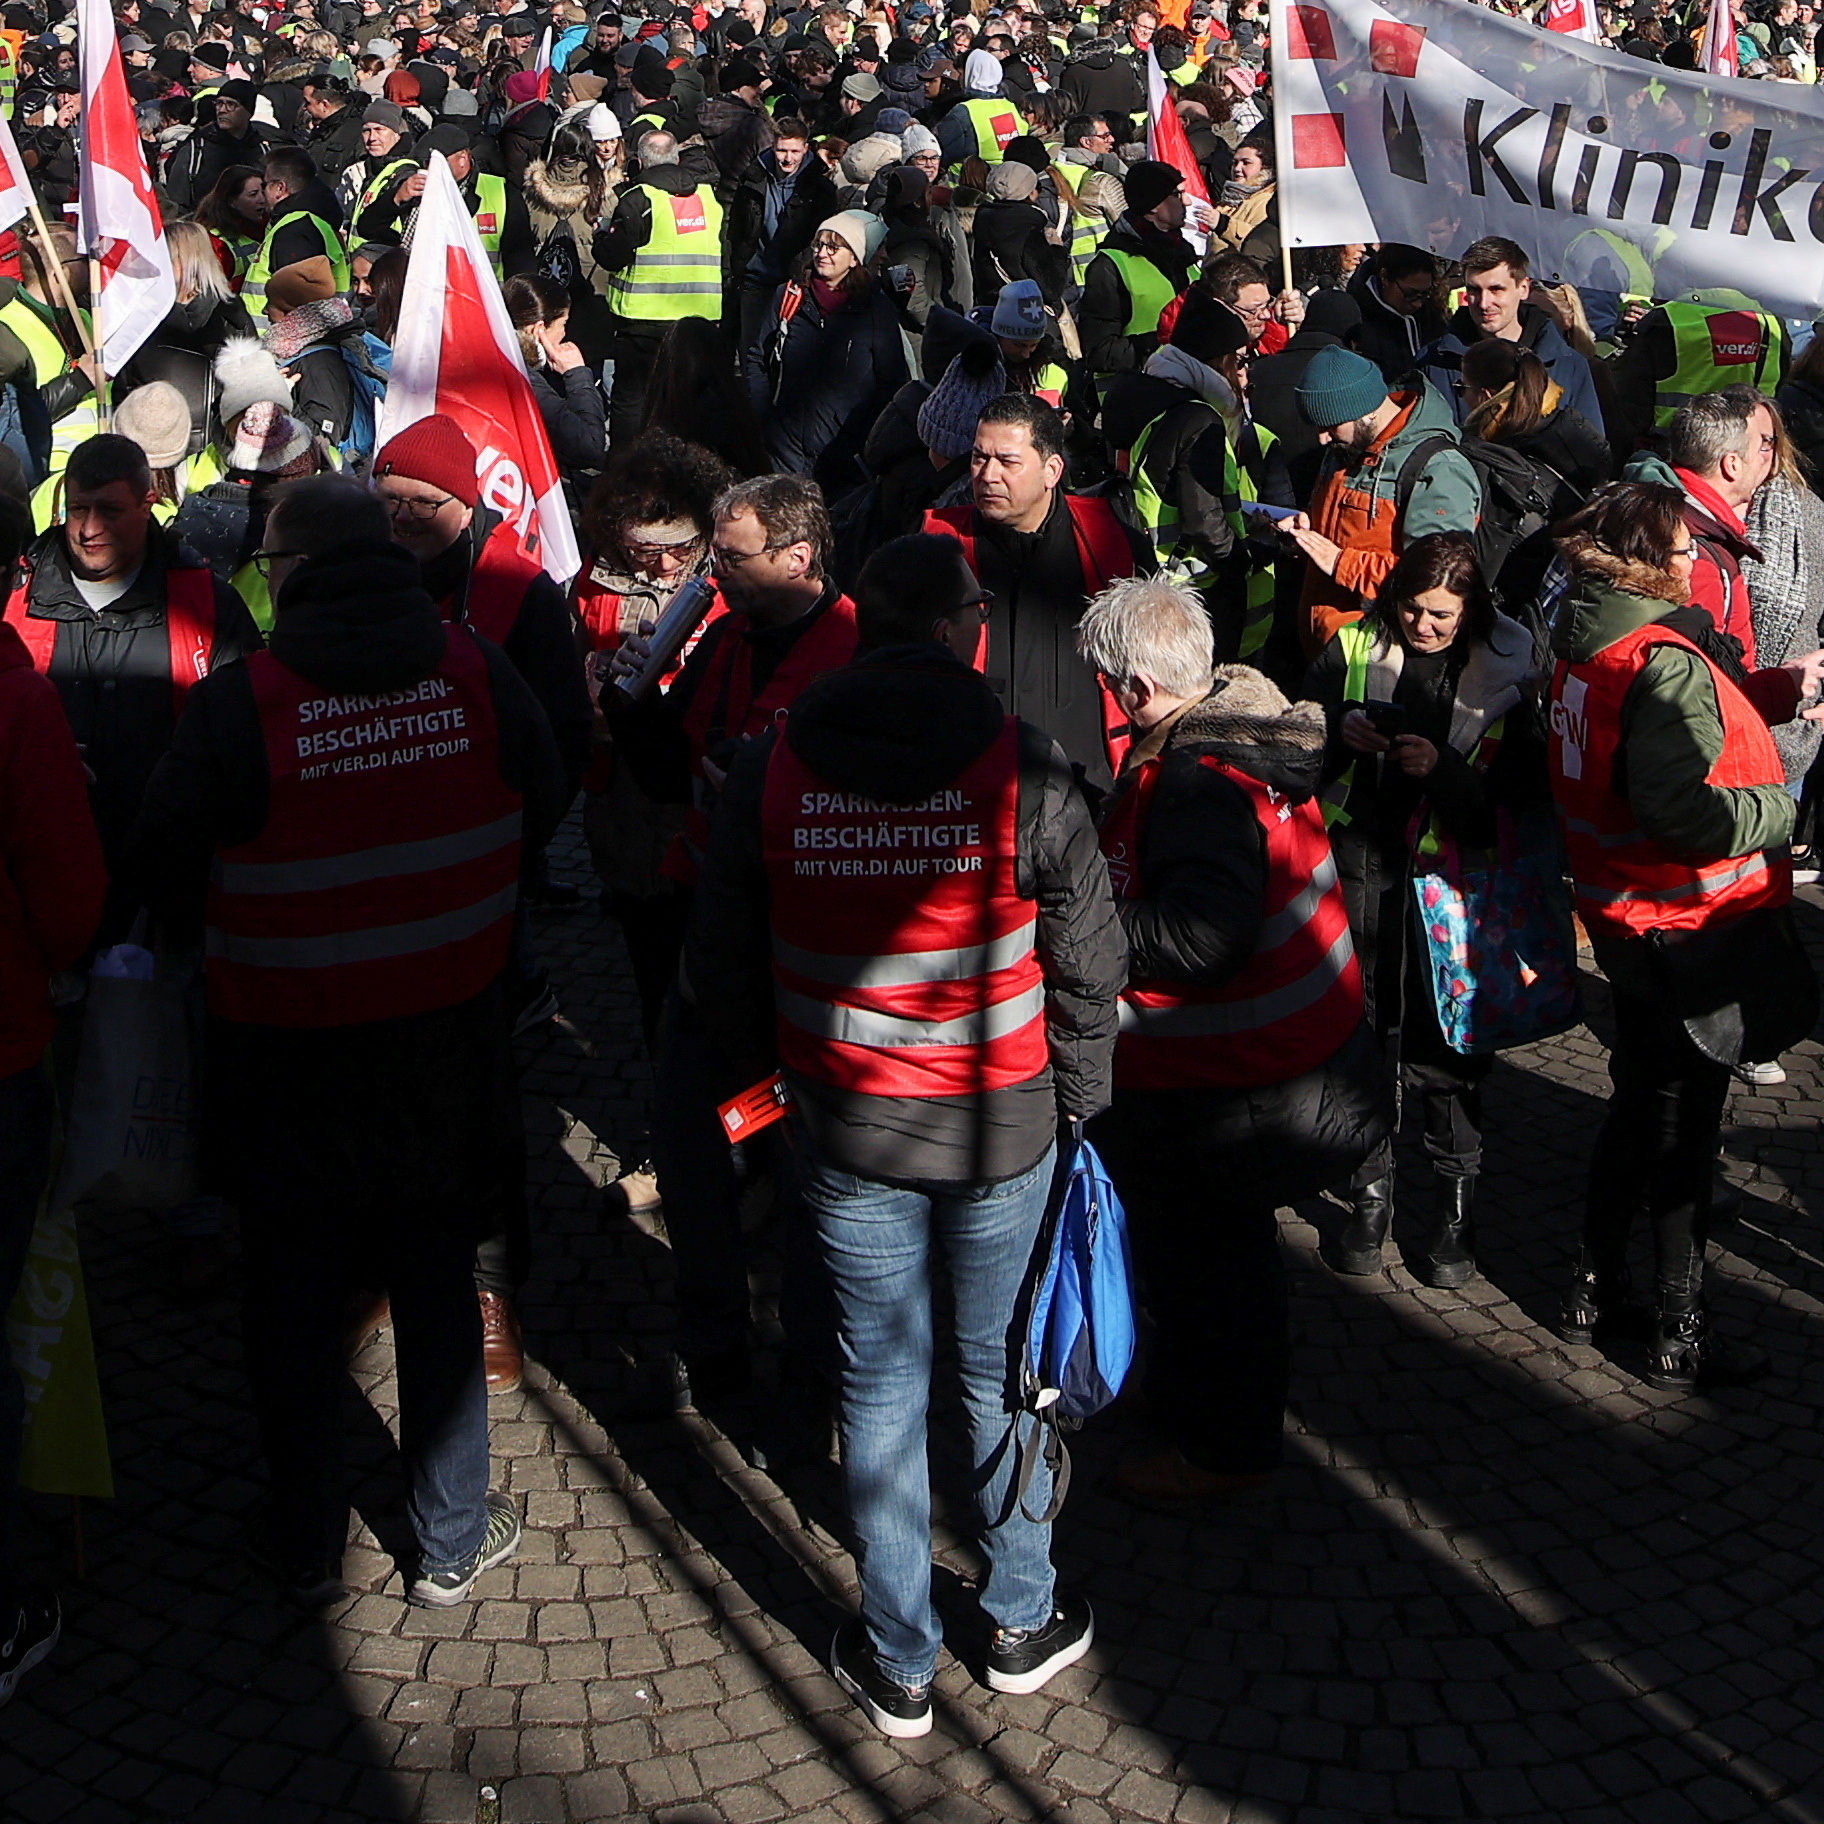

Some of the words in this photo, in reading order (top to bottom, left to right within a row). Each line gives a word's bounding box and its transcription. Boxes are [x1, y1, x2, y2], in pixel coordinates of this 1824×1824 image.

[676, 216, 705, 227] ver.di
[1716, 342, 1758, 357] ver.di
[297, 677, 455, 724] SPARKASSEN-
[295, 707, 467, 759] BESCHÄFTIGTE
[299, 763, 330, 782] MIT
[330, 751, 388, 775] VER.DI
[390, 745, 425, 768] AUF
[426, 738, 470, 759] TOUR
[793, 820, 981, 850] BESCHÄFTIGTE
[794, 859, 826, 876] MIT
[828, 859, 887, 877] VER.DI
[892, 858, 929, 875] AUF
[932, 856, 983, 874] TOUR
